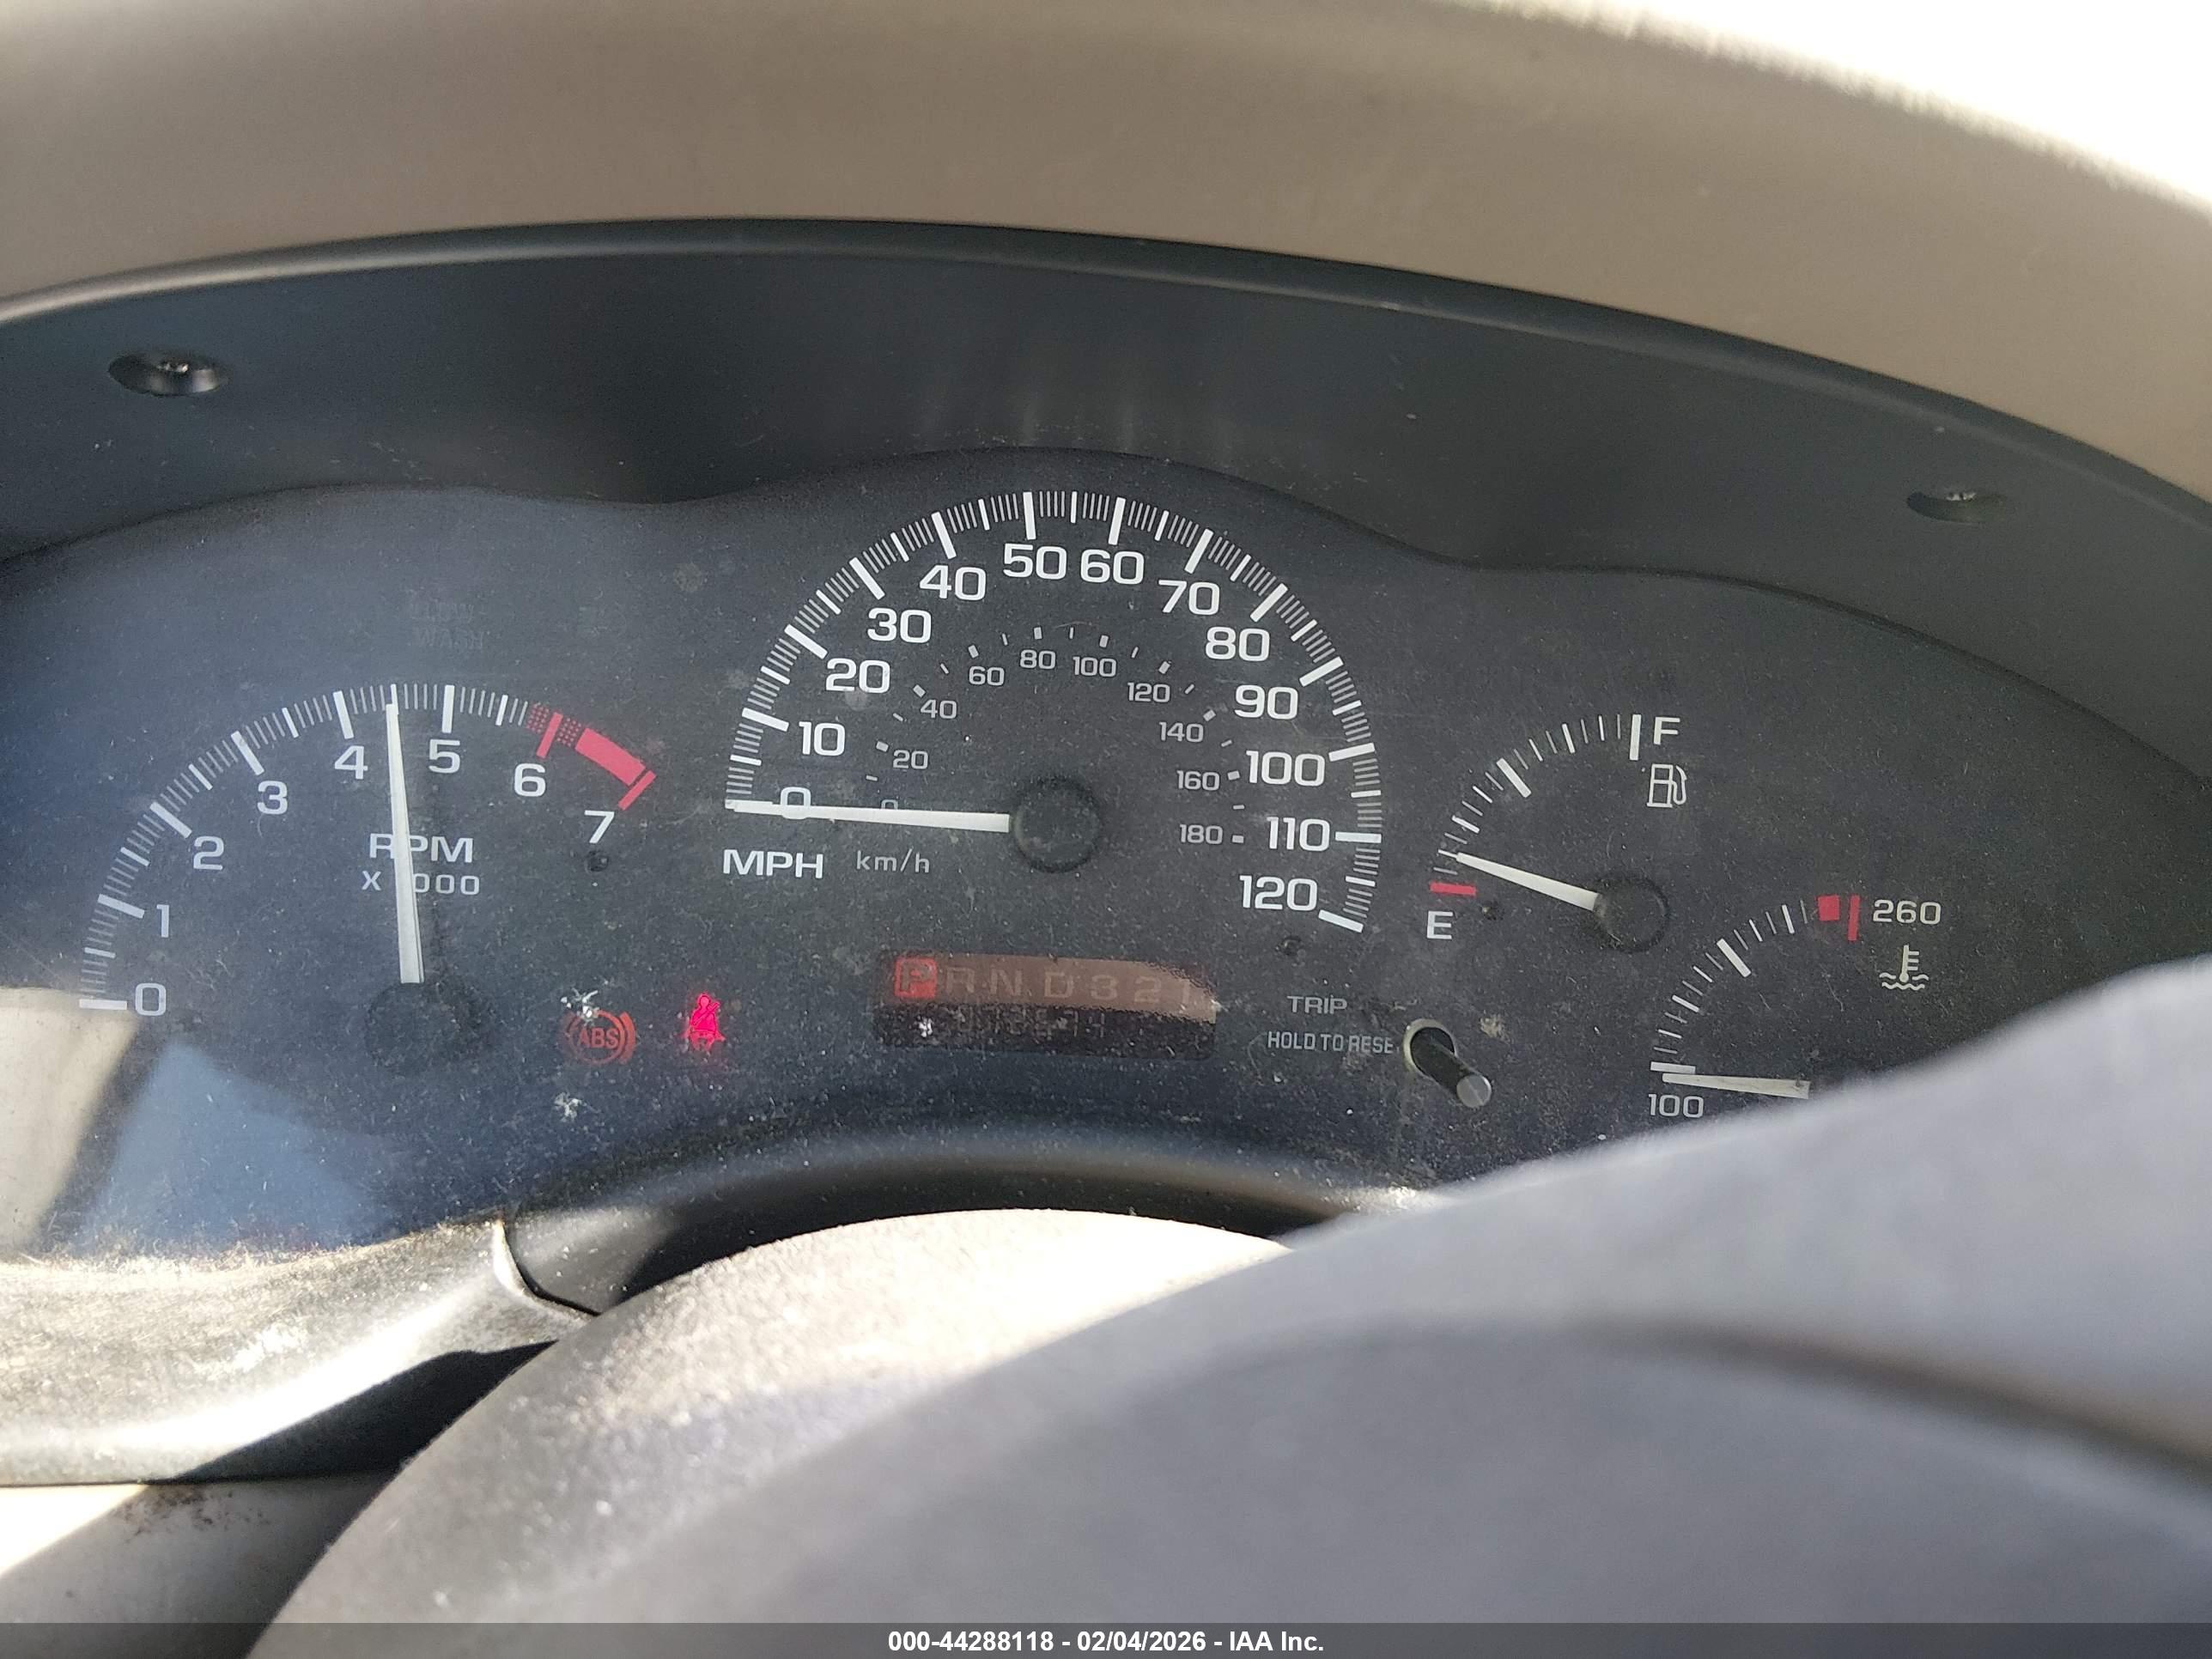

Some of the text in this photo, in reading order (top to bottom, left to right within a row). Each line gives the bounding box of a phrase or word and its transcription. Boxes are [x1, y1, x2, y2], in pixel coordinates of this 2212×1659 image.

[1003, 544, 1066, 580] 50
[1080, 550, 1144, 584] 60
[920, 565, 987, 600] 40
[1158, 580, 1220, 616] 70
[867, 608, 932, 643] 30
[1019, 650, 1056, 670] 80
[1206, 627, 1269, 662] 80
[826, 659, 890, 694] 20
[969, 667, 1005, 685] 60
[1073, 656, 1116, 677] 100
[1127, 683, 1170, 703] 120
[1235, 685, 1298, 720] 90
[921, 700, 957, 720] 40
[799, 721, 845, 756] 10
[1159, 722, 1203, 743] 140
[1654, 717, 1680, 744] F
[334, 746, 368, 780] 4
[428, 740, 460, 775] 5
[893, 750, 928, 769] 20
[1246, 750, 1325, 787] 100
[514, 764, 546, 797] 6
[1177, 770, 1220, 791] 160
[257, 781, 289, 814] 3
[780, 787, 811, 819] 0
[585, 811, 614, 844] 7
[1180, 824, 1223, 845] 180
[1267, 817, 1330, 852] 110
[193, 836, 223, 870] 2
[368, 834, 473, 863] RPM
[723, 848, 823, 878] MPH
[857, 848, 930, 873] km/h
[415, 874, 480, 895] 000
[1239, 875, 1317, 911] 120
[156, 904, 170, 938] 1
[1426, 911, 1453, 939] E
[1873, 900, 1942, 924] 260
[900, 961, 931, 994] P
[945, 967, 975, 994] R
[989, 968, 1022, 996] N
[1044, 972, 1073, 999] D
[1091, 975, 1118, 1000] 3
[1134, 976, 1162, 1003] 2
[135, 983, 167, 1017] 0
[1287, 995, 1347, 1014] TRIP
[578, 1027, 620, 1049] ABS
[1267, 1030, 1400, 1054] HOLD TO RESE
[1648, 1093, 1704, 1118] 100
